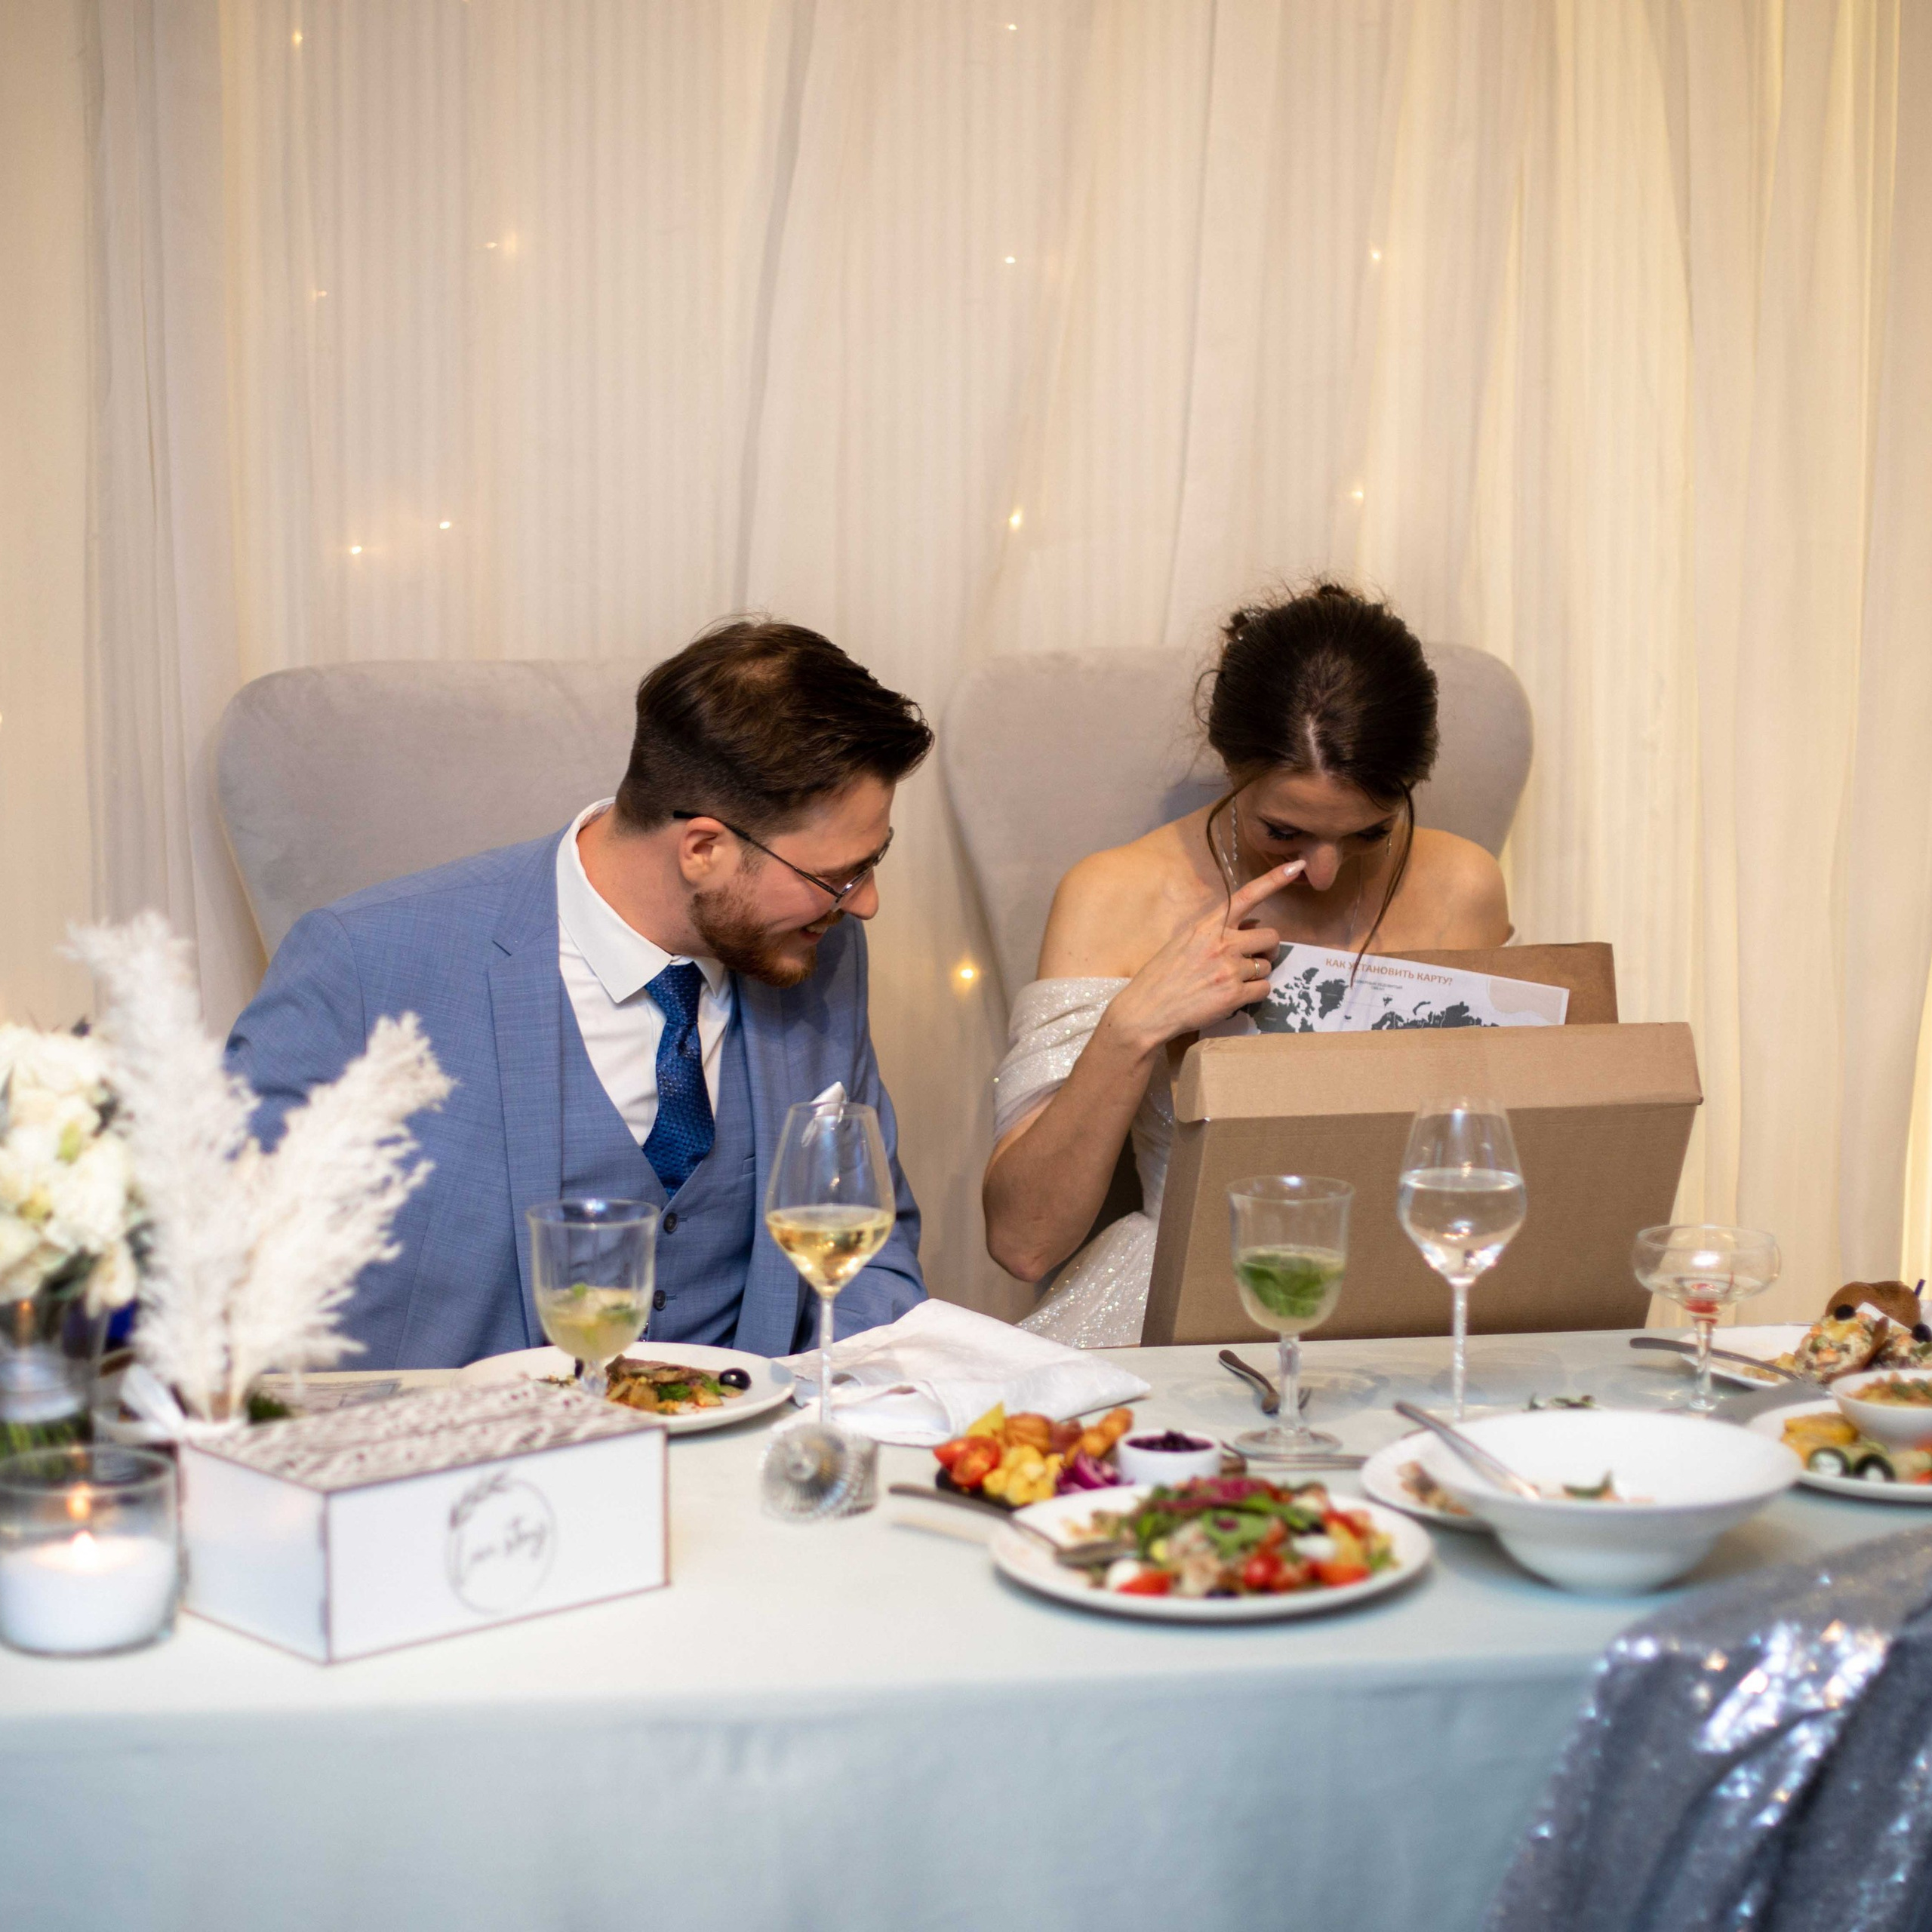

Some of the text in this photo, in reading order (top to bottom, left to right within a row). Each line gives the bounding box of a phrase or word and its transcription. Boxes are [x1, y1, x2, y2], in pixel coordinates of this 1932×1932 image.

[1326, 958, 1345, 968] КАК
[1349, 961, 1414, 979] УТАНОВИТЬ
[1417, 972, 1454, 986] КАРТУ?
